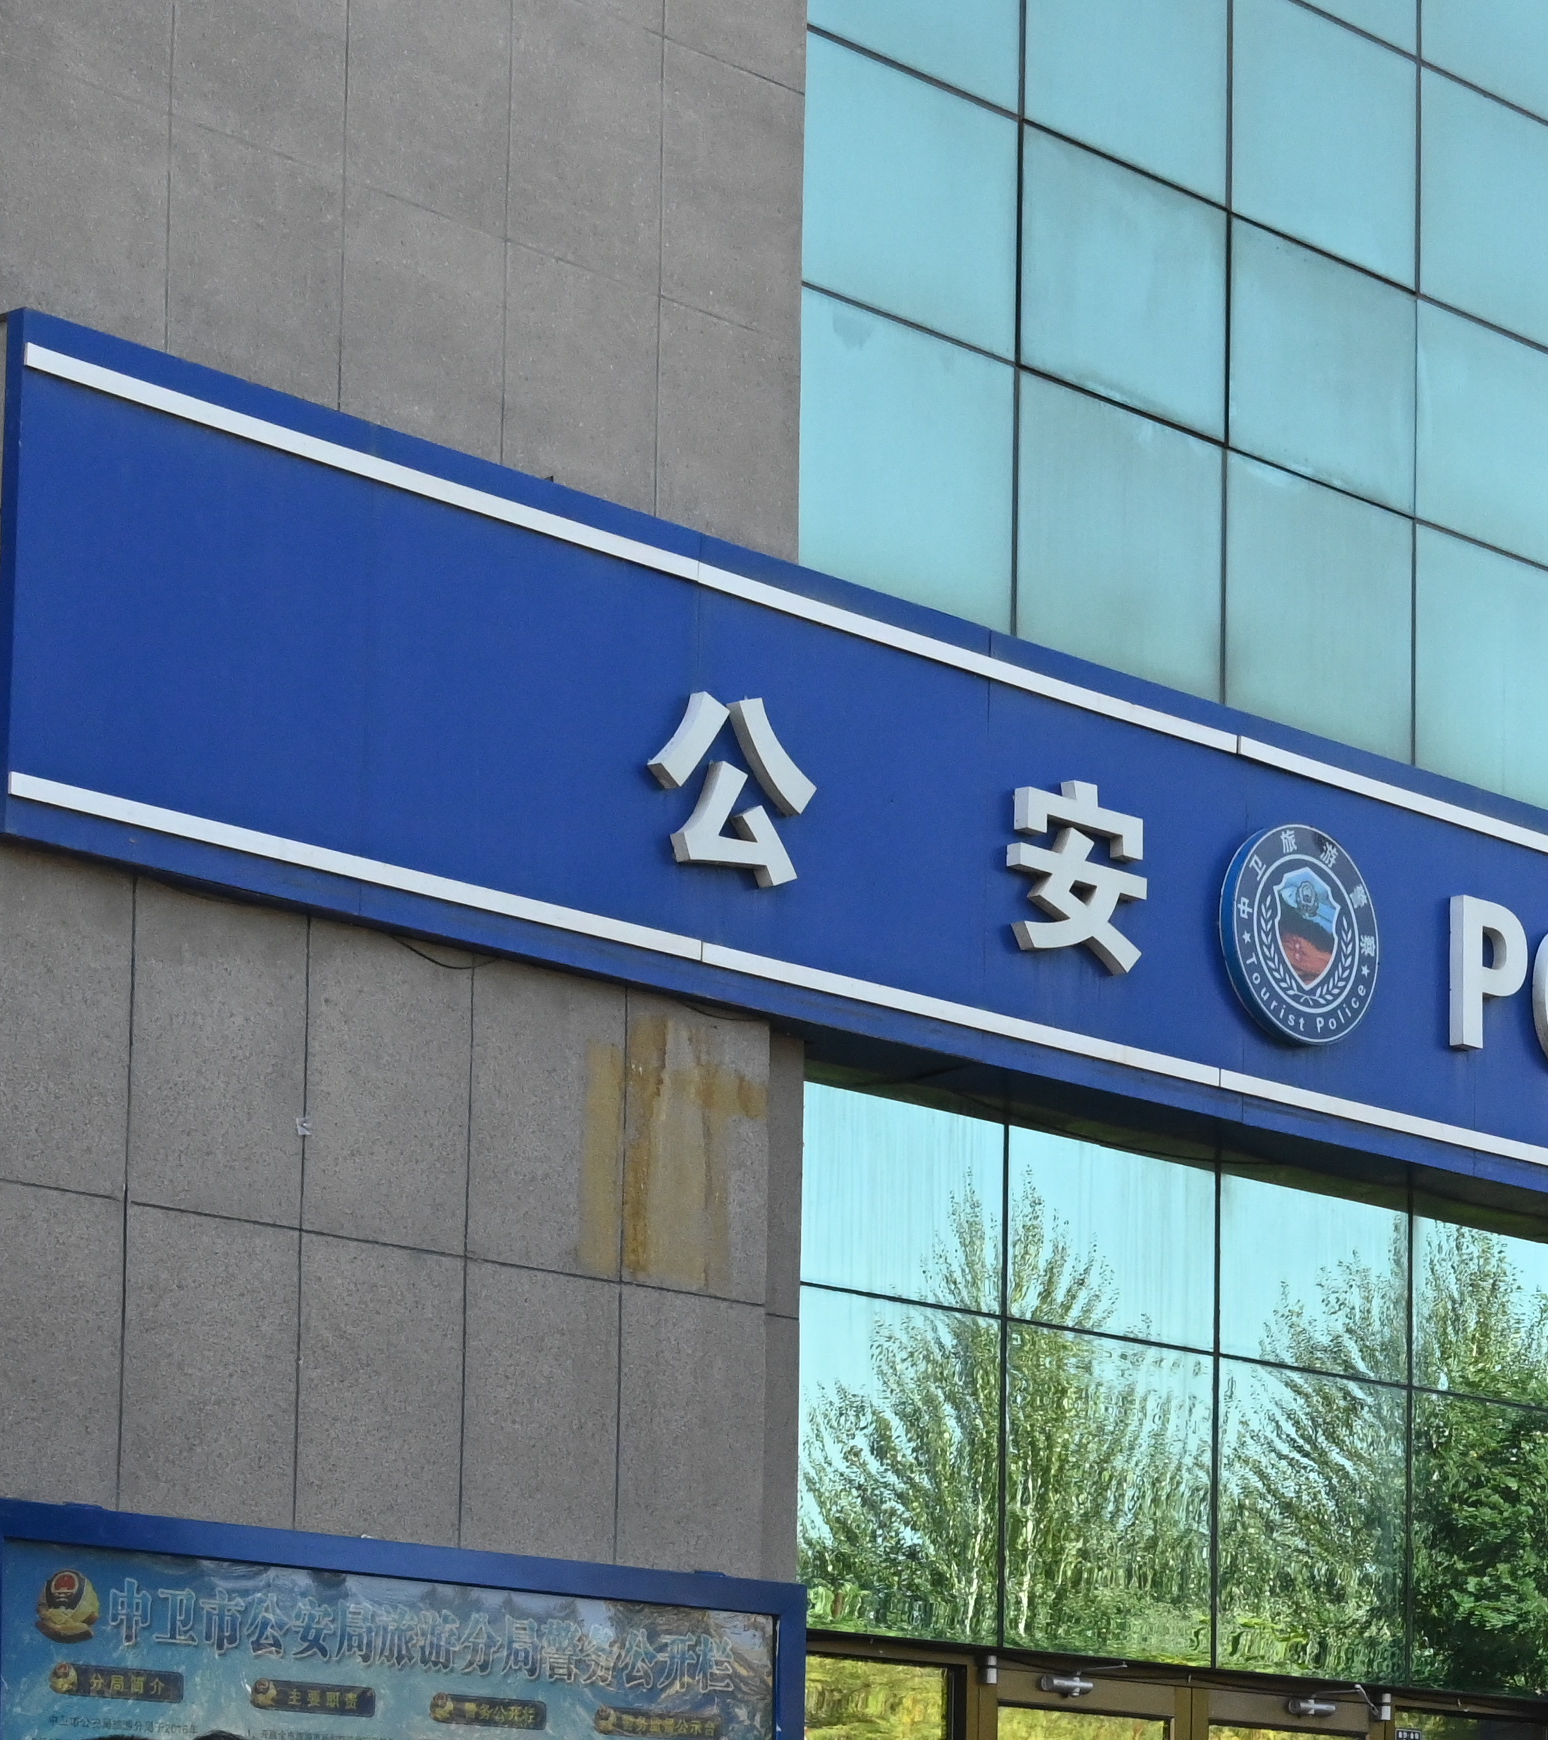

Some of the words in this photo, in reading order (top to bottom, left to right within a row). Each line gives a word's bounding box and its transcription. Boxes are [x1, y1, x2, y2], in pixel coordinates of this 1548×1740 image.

[647, 691, 1149, 975] 公安
[1246, 958, 1305, 1032] Tourist
[1316, 984, 1367, 1033] Police
[109, 1577, 735, 1694] 中卫市公安局旅游分局警务公开栏
[89, 1673, 166, 1697] 分局简介
[287, 1688, 359, 1710] 主要职责
